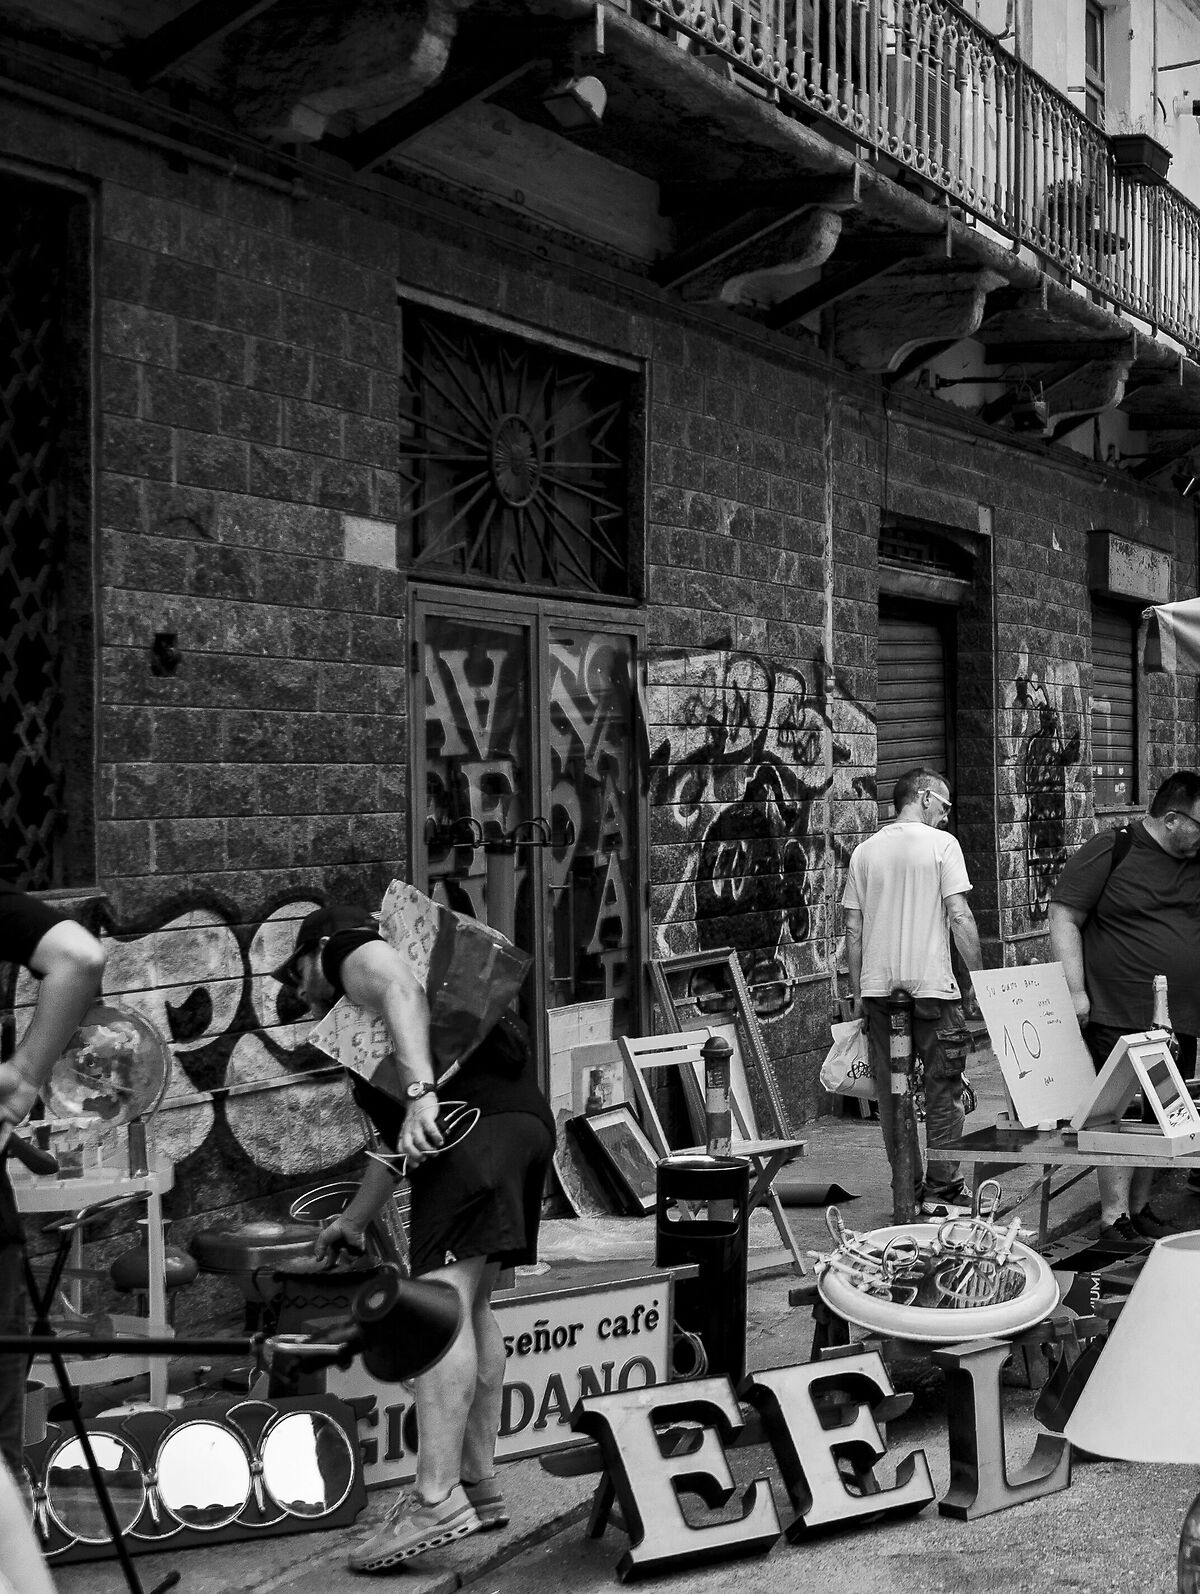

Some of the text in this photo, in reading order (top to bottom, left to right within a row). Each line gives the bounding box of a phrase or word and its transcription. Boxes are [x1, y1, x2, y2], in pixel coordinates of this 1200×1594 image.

[1003, 1019, 1042, 1080] 10
[503, 1299, 660, 1358] señor café
